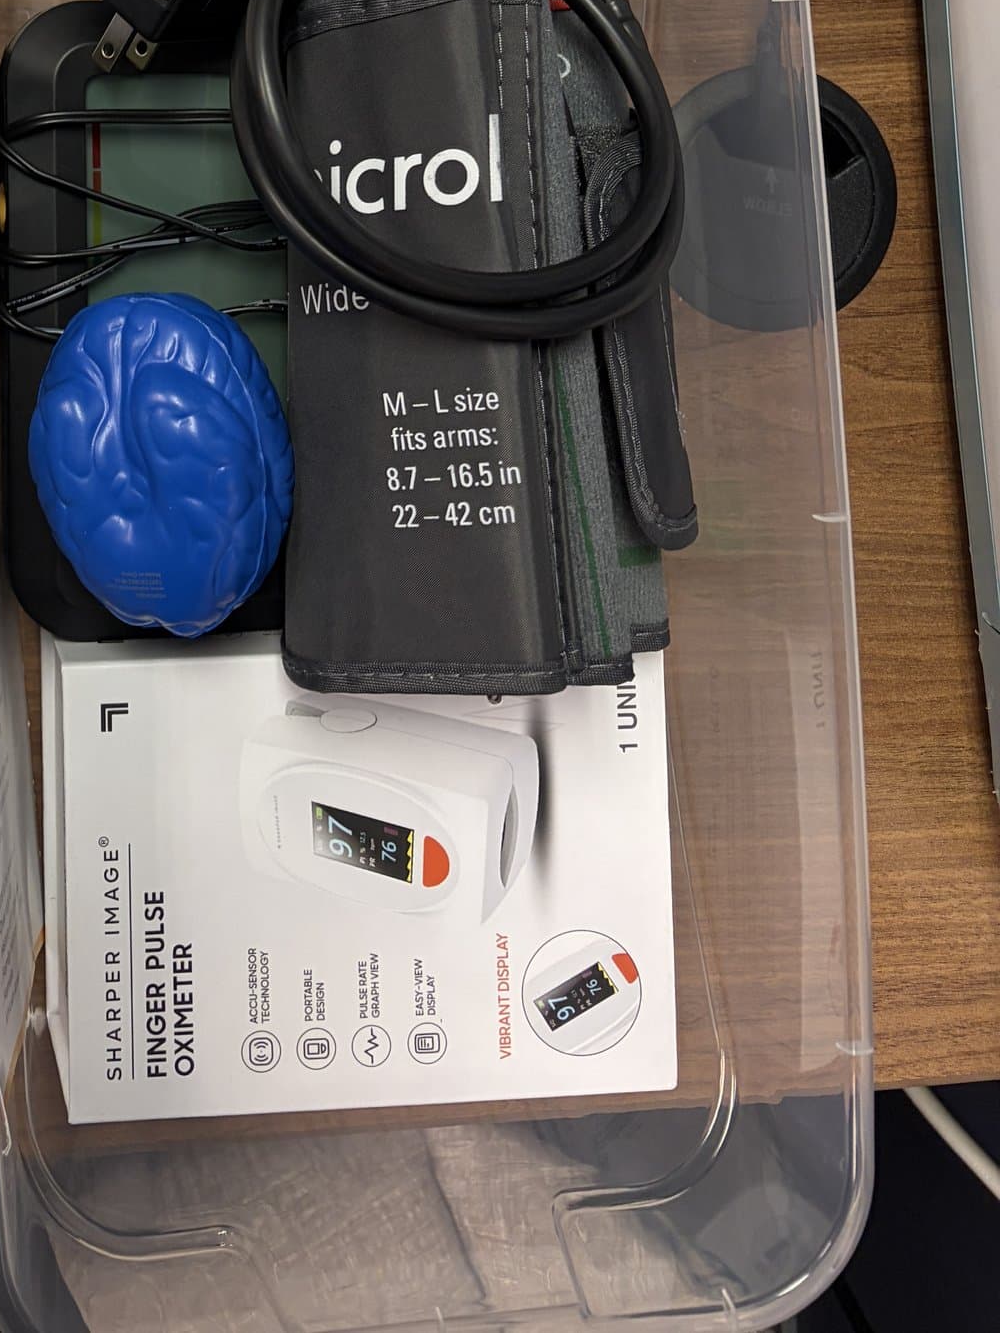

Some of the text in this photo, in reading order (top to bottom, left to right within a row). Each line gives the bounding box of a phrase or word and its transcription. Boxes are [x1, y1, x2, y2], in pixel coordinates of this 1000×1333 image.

[314, 113, 505, 215] icrol
[301, 284, 371, 316] Wide
[382, 391, 407, 418] M
[434, 389, 449, 414] L
[454, 387, 500, 413] size
[391, 425, 499, 452] fits arms:
[386, 466, 417, 491] 8.7
[447, 463, 494, 489] 16.5
[499, 462, 521, 485] in
[392, 504, 419, 528] 22
[445, 501, 473, 526] 42
[478, 502, 516, 525] cm
[619, 743, 638, 753] 1
[328, 815, 352, 858] 97
[381, 841, 397, 862] 76
[144, 891, 167, 1078] FINGER PULSE
[172, 943, 195, 1077] OXIMETER
[247, 947, 259, 1025] ACCU-SENSOR
[259, 951, 270, 1024] TECHNOLOGY
[303, 969, 314, 1022] PORTABLE
[315, 982, 326, 1021] DESIGN
[357, 960, 369, 1019] PULSE RATE
[369, 953, 381, 1019] GRAPH VIEW
[413, 958, 425, 1016] EASY-VIEW
[426, 975, 436, 1016] DISPLAY
[495, 933, 512, 1060] VIBRANT DISPLAY
[105, 951, 122, 1081] SHARPER
